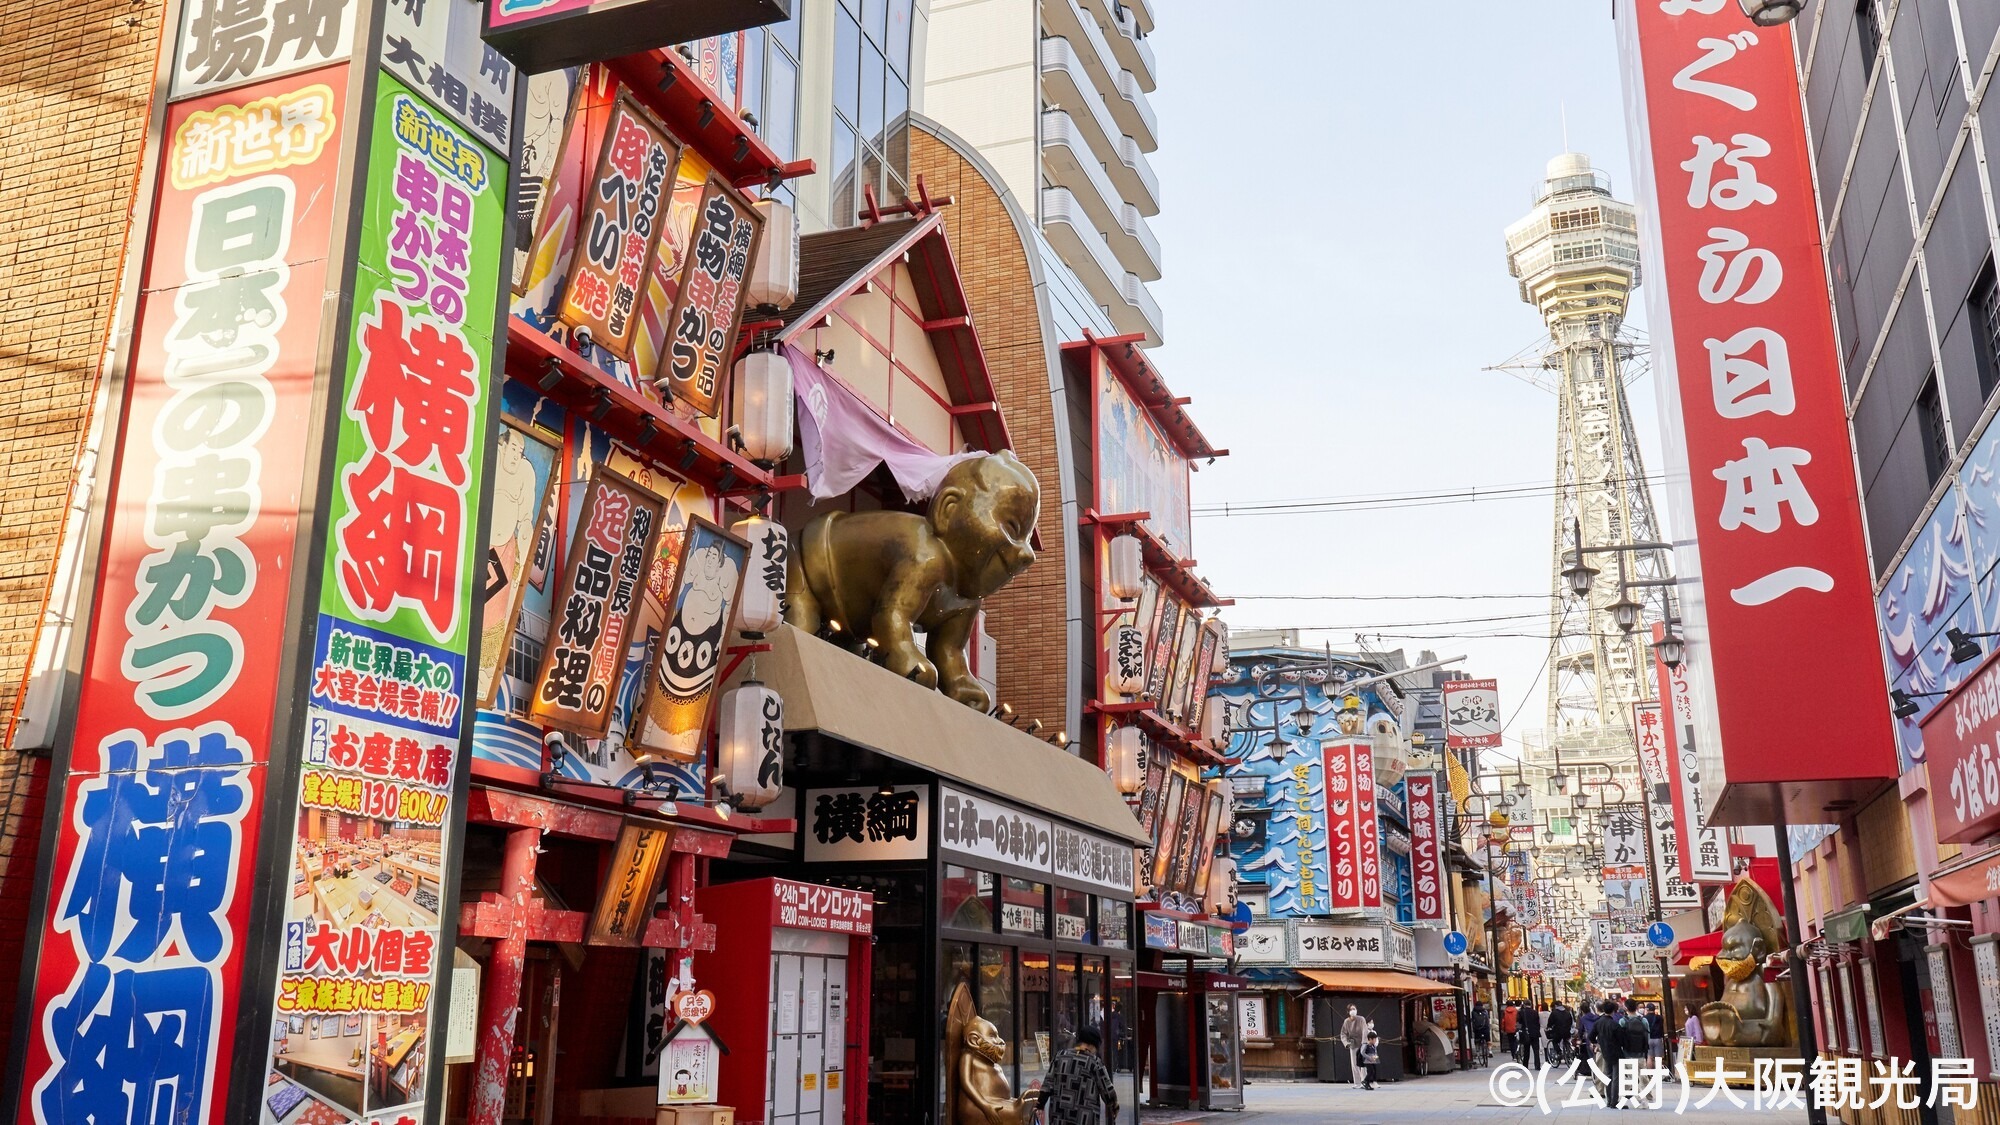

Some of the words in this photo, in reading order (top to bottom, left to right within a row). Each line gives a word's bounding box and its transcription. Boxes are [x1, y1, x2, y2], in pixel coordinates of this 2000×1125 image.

[386, 35, 508, 147] 大相撲
[176, 94, 329, 179] 新世界
[397, 103, 486, 189] 新世界
[390, 157, 440, 303] 串かつ
[430, 182, 471, 325] 日本一の
[572, 112, 651, 320] 豚ぺい焼き
[608, 142, 668, 338] なにわの鉄板焼き
[672, 194, 737, 381] 名物串かつ
[696, 219, 752, 398] 横綱定番の一品
[1660, 0, 1835, 606] ぐなら日本一
[128, 184, 288, 712] 日本一の串かつ
[338, 299, 476, 634] 横綱
[542, 484, 631, 711] 逸品料理
[586, 507, 652, 713] 料理長自慢の
[315, 665, 460, 726] 大宴会場完備!!
[329, 632, 451, 690] 新世界最大の
[312, 719, 328, 762] 2階
[329, 724, 453, 787] お座敷席
[1330, 753, 1348, 793] 名物
[1356, 753, 1372, 793] 名物
[1640, 711, 1660, 758] 串かつ
[1950, 729, 2000, 824] づぼら
[812, 792, 921, 845] 横綱
[943, 794, 1051, 867] 日本一の串かつ
[1055, 829, 1081, 876] 横綱
[1610, 815, 1637, 868] 串か
[610, 829, 654, 935] ビリケン神社
[781, 883, 798, 905] 24h
[798, 886, 872, 919] コインロッカー
[781, 905, 797, 926] ¥200
[36, 728, 246, 1125] 横綱
[287, 923, 302, 970] 2階
[303, 923, 434, 975] 大小個室
[1302, 933, 1380, 955] づぼらや本店
[277, 978, 432, 1013] ご家族連れに最適!!
